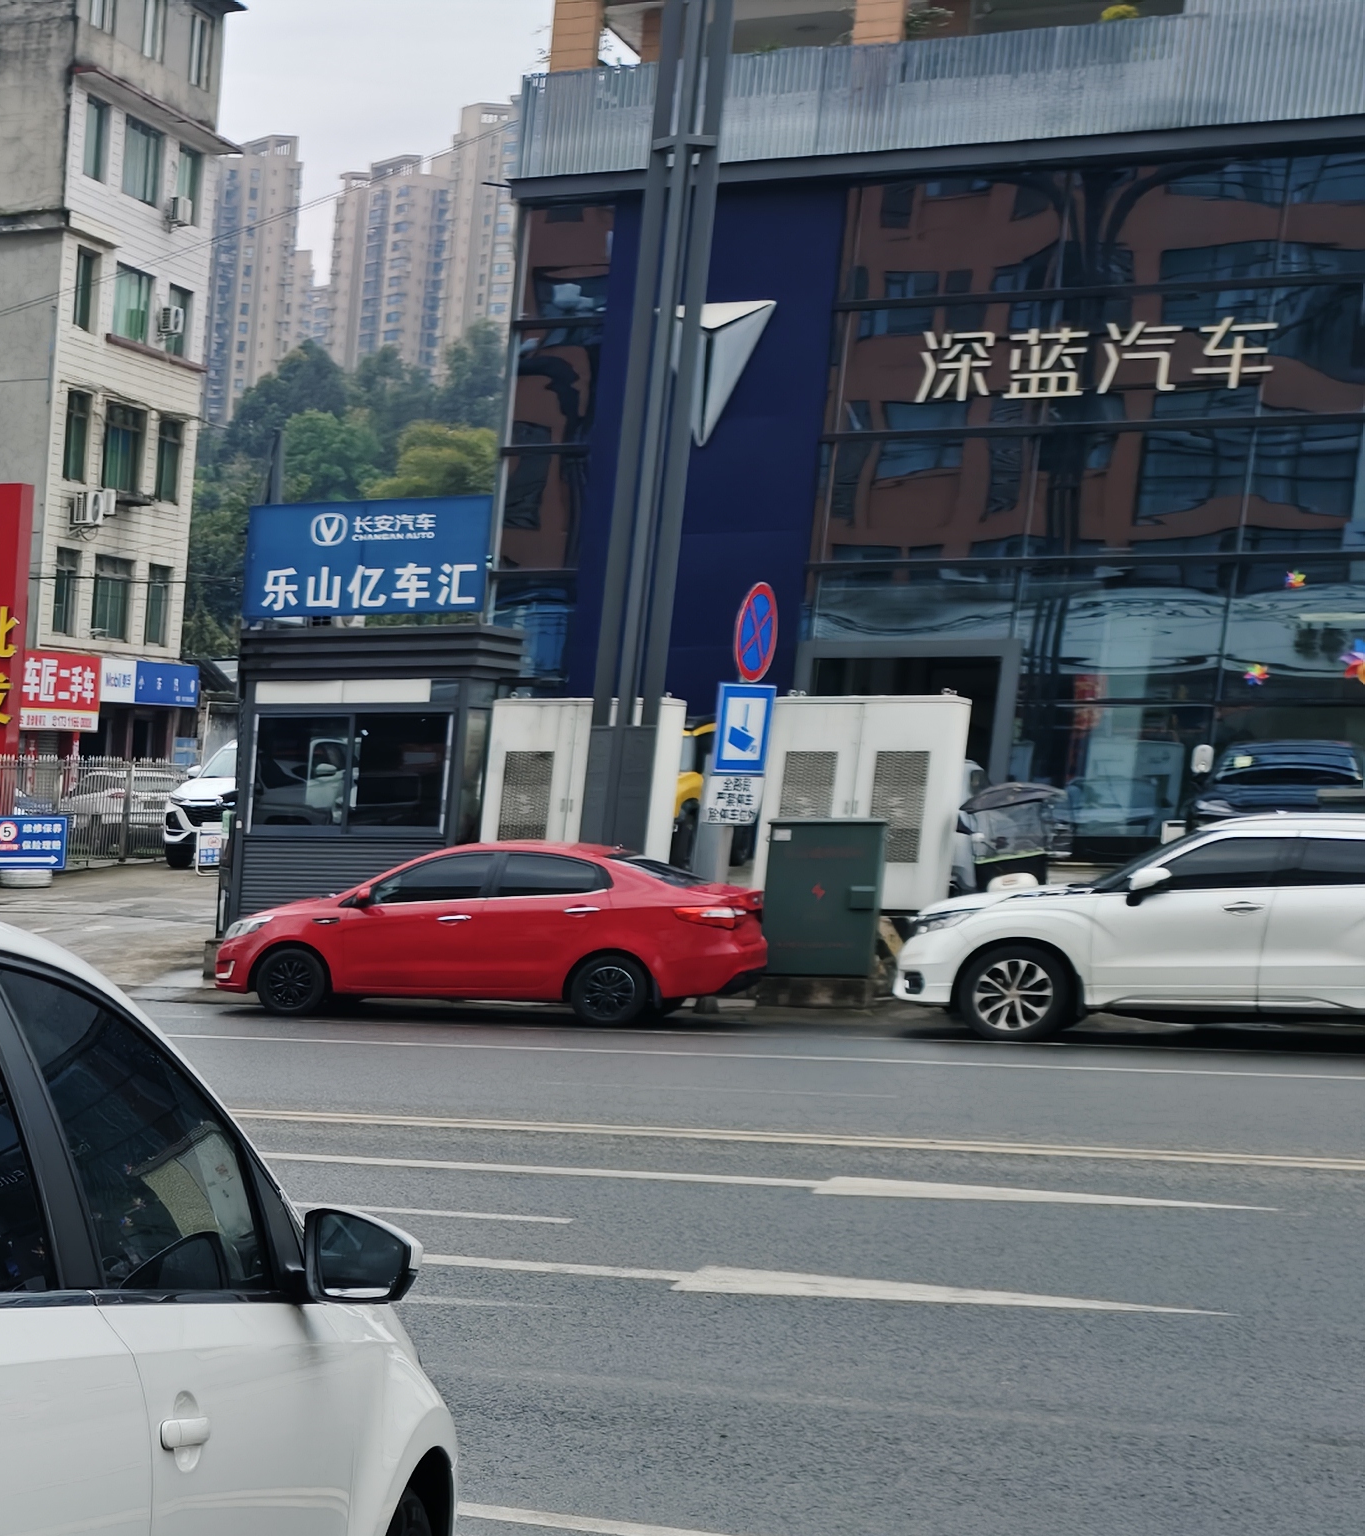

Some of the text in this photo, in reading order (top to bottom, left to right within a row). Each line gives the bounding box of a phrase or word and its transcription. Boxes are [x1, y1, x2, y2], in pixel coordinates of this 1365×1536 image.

[915, 317, 1279, 403] 深蓝汽车
[353, 514, 436, 532] 长安汽车
[406, 531, 435, 540] AUTO
[261, 563, 478, 611] 乐山亿车汇
[3, 826, 12, 838] 5
